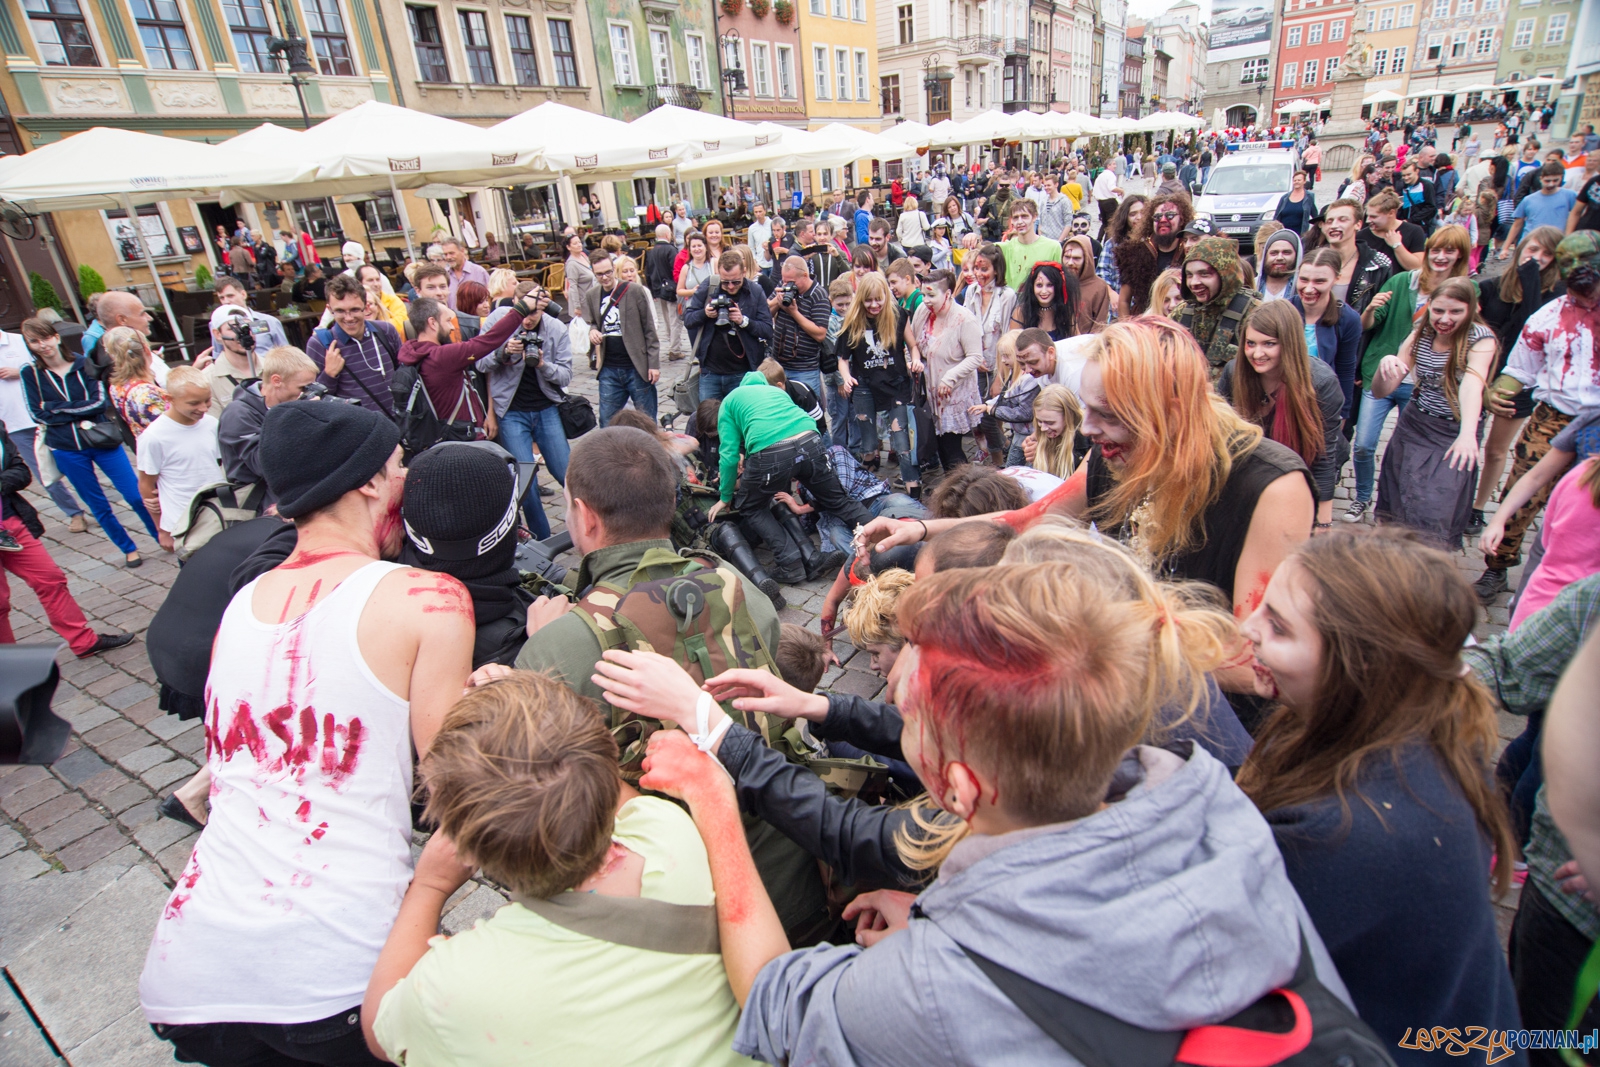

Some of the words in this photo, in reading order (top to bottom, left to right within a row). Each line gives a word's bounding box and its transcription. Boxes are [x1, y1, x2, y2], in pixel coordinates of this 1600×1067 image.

[494, 154, 516, 165] TYSKIE
[650, 150, 667, 159] TYSKIE
[390, 159, 419, 171] TYSKIE
[576, 155, 597, 166] TYSKIE
[863, 357, 895, 369] PYRKN
